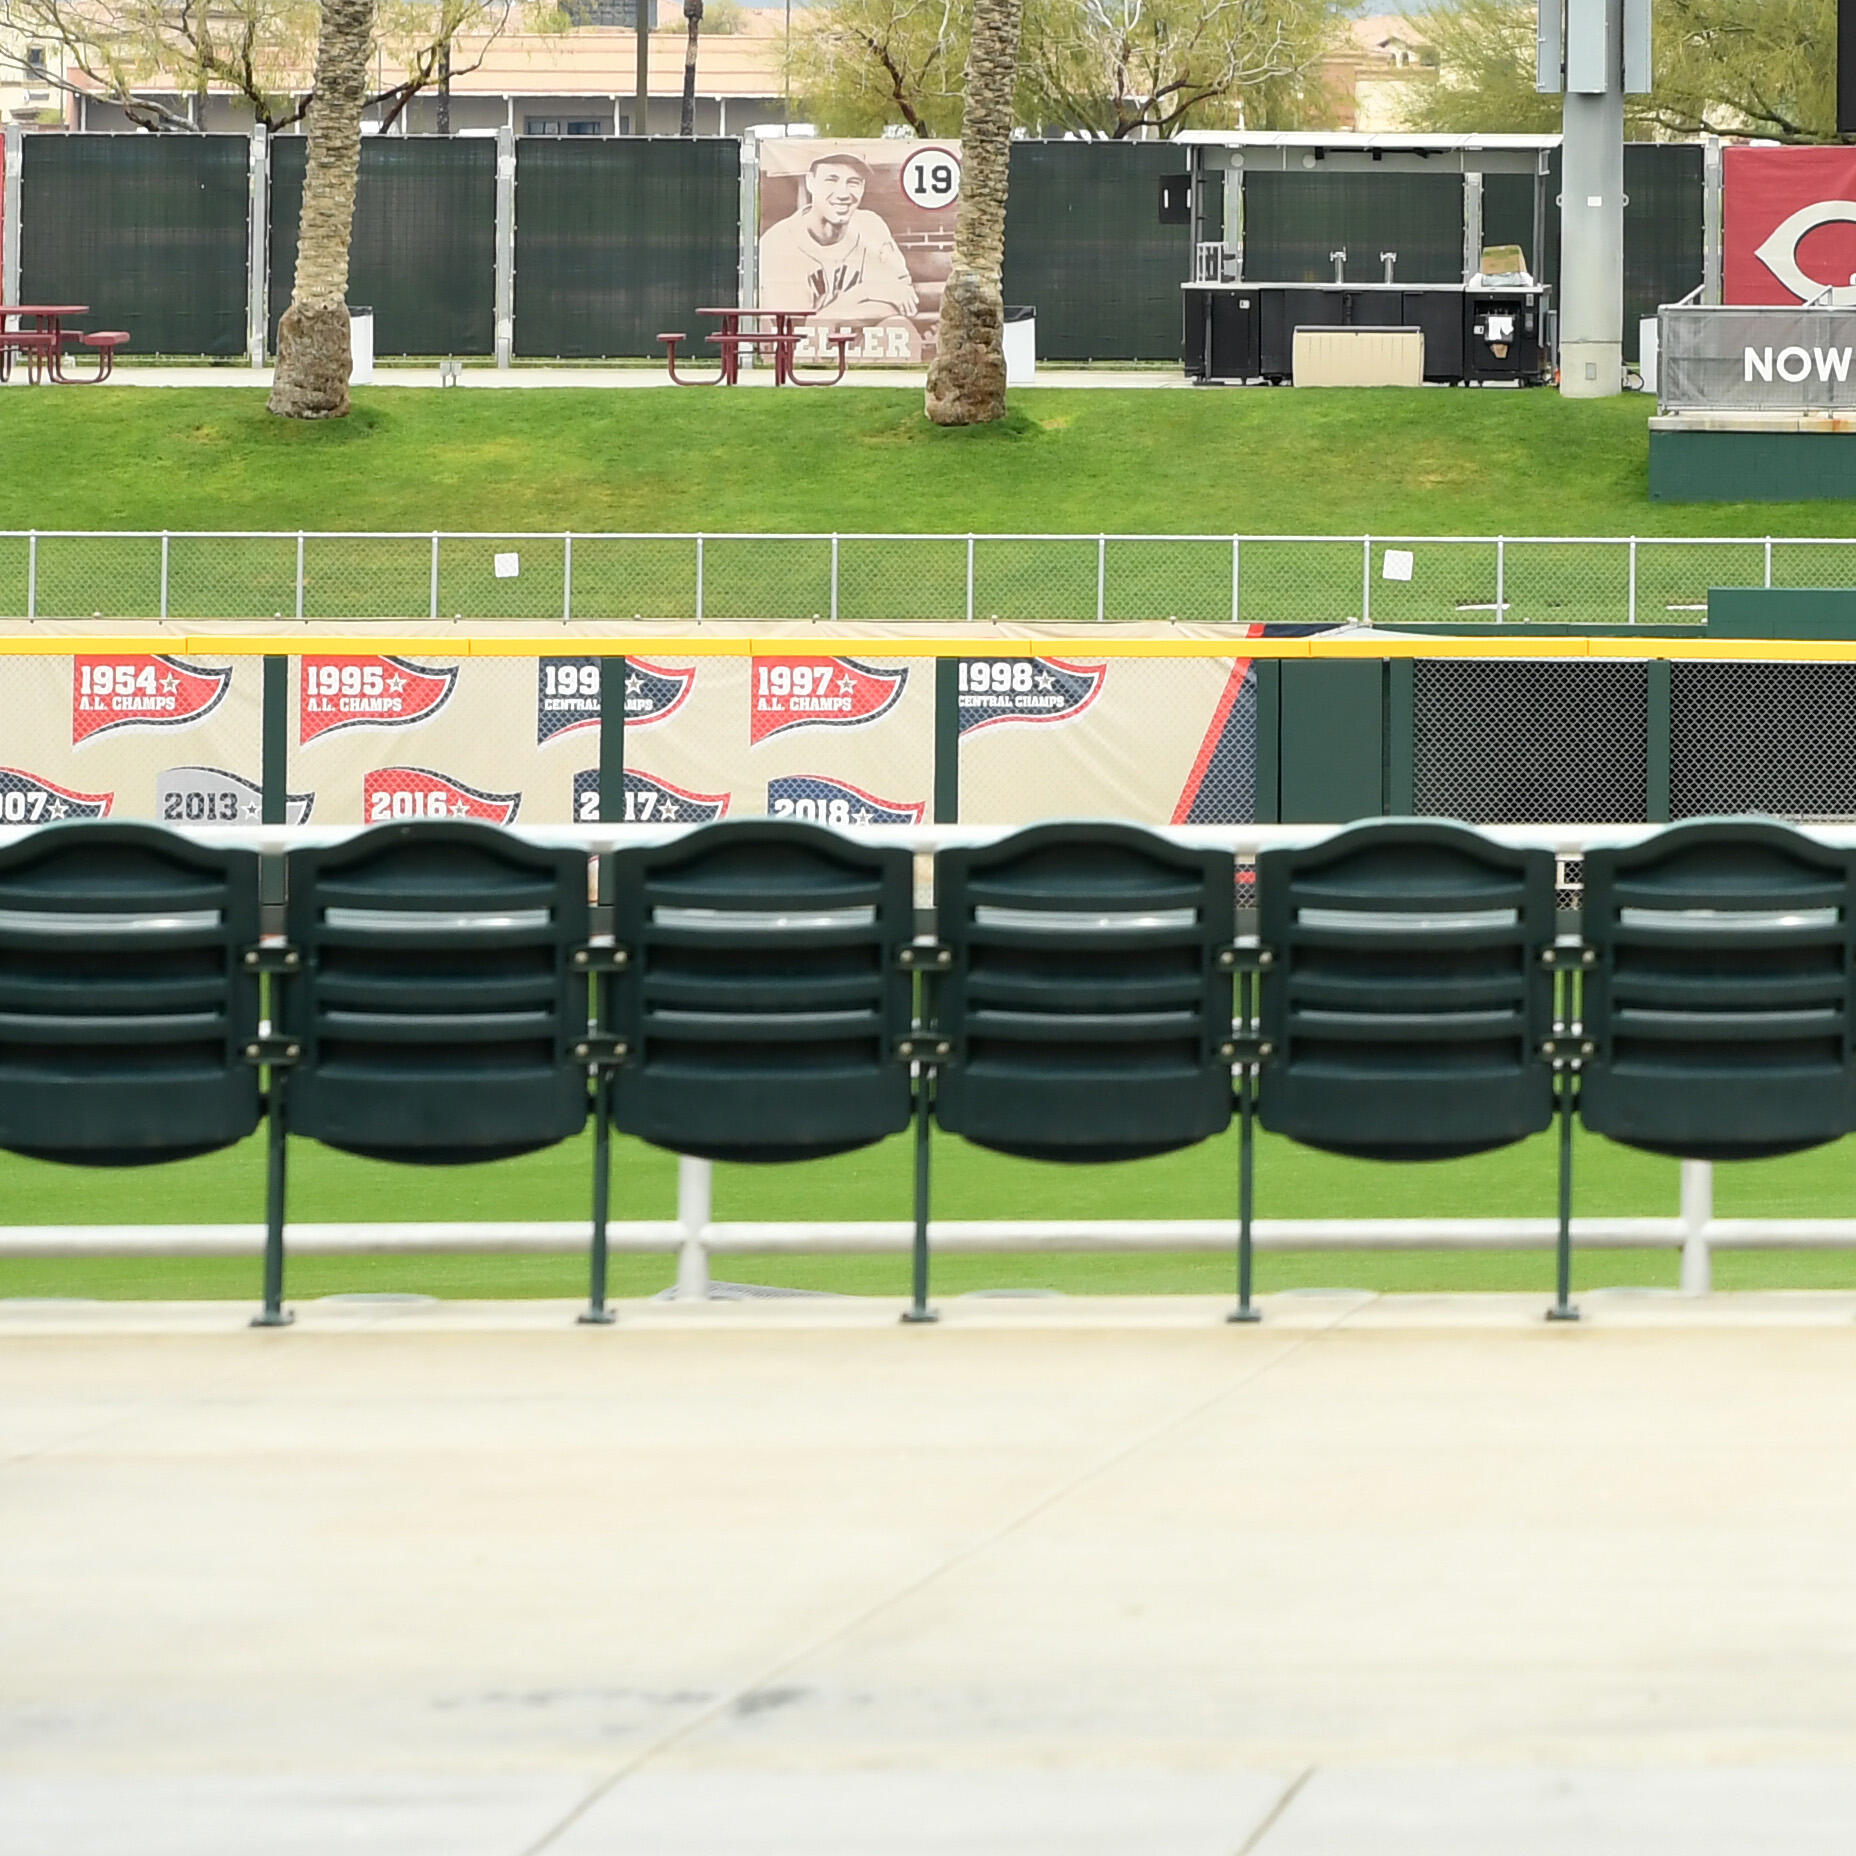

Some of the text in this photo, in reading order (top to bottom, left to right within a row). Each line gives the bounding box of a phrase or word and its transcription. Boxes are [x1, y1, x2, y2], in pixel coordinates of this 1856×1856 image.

[914, 165, 952, 194] 19
[1743, 347, 1852, 383] NOW
[80, 665, 157, 695] 1954
[307, 666, 384, 696] 1995
[545, 665, 600, 695] 199
[758, 666, 835, 696] 1997
[959, 662, 1034, 693] 1998
[79, 696, 177, 711] A.L. CHAMPS
[307, 697, 402, 712] A.L. CHAMPS
[544, 698, 602, 711] CENTRAL
[757, 697, 853, 712] A.L. CHAMPS
[958, 695, 1065, 708] CENTRAL CHAMPS
[163, 792, 239, 822] 2013
[370, 791, 448, 821] 2016
[580, 791, 658, 821] 217
[774, 797, 850, 826] 2018
